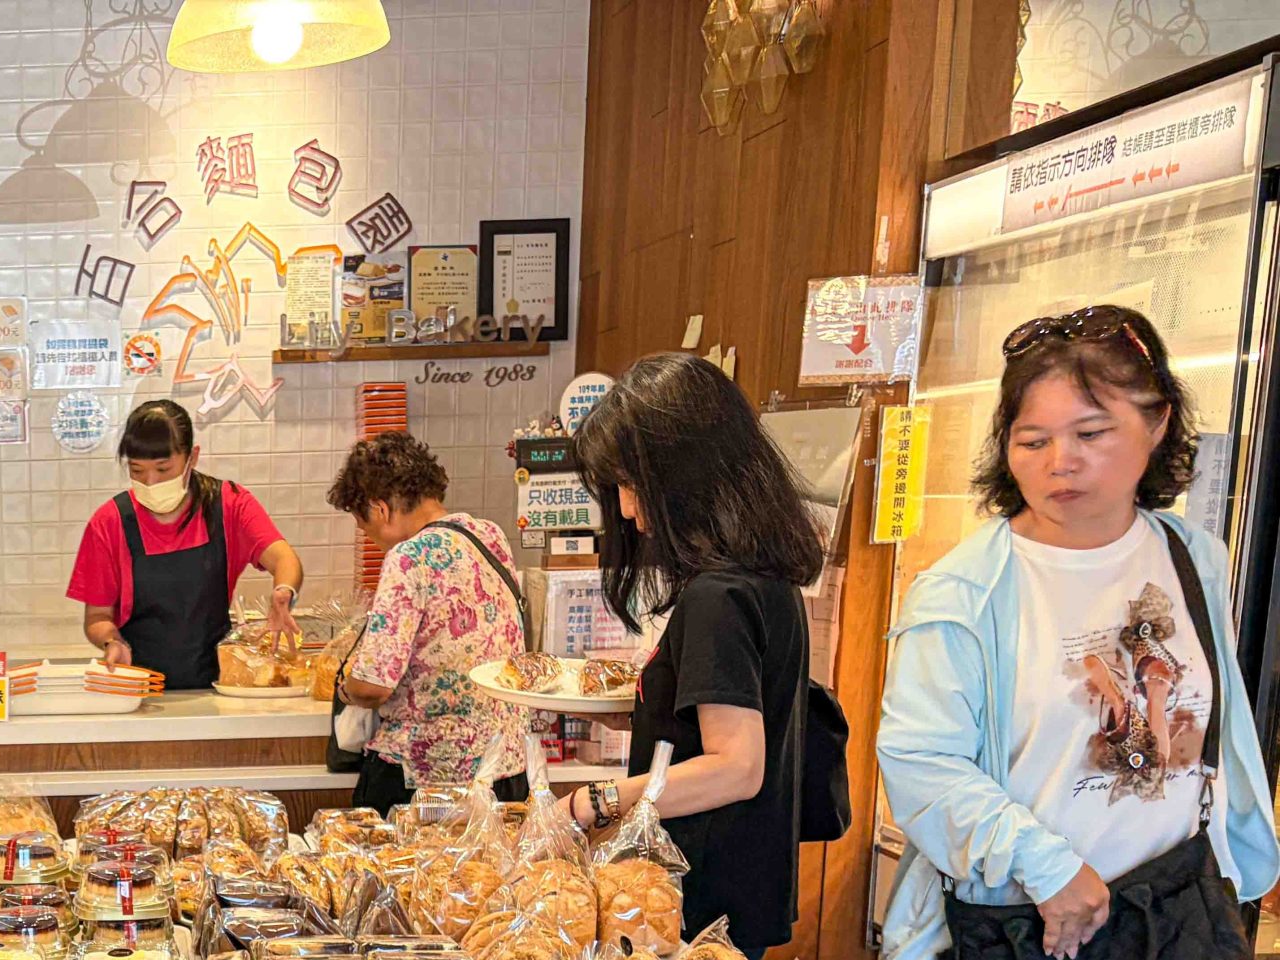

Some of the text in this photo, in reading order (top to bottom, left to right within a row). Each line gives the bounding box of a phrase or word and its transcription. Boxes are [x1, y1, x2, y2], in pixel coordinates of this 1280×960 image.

[1122, 105, 1238, 159] 結帳請至蛋糕櫃旁排隊
[1010, 134, 1118, 195] 請依指示方向排隊
[280, 305, 545, 358] Lily Bakery
[414, 361, 473, 384] Since
[528, 488, 590, 506] 只收現金
[891, 410, 912, 537] 請不要從旁邊開冰箱
[527, 508, 590, 527] 沒有載具
